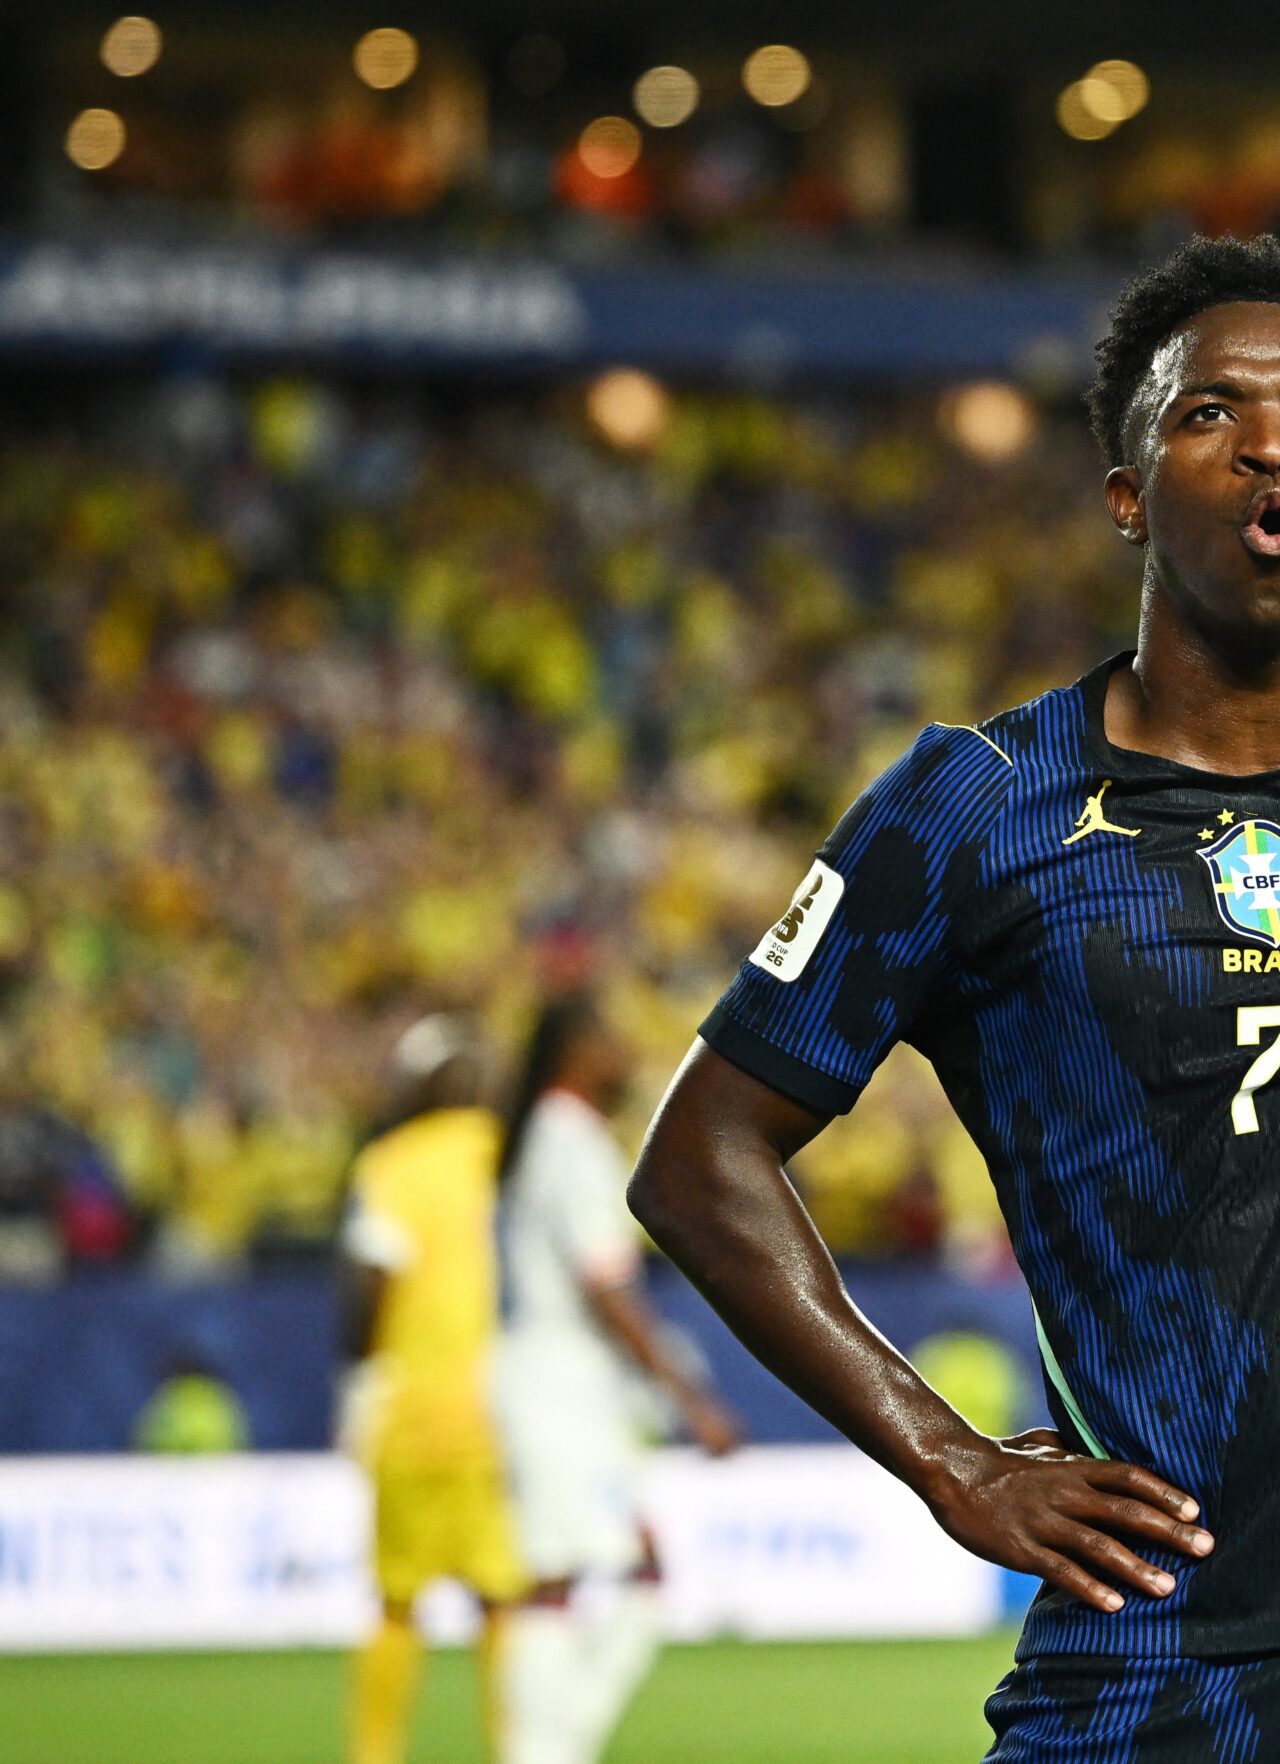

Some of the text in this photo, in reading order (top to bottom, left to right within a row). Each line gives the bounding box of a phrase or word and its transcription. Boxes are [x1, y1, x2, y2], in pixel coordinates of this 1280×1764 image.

[1243, 874, 1280, 890] CBF
[776, 945, 789, 955] CUP
[766, 950, 784, 967] 26
